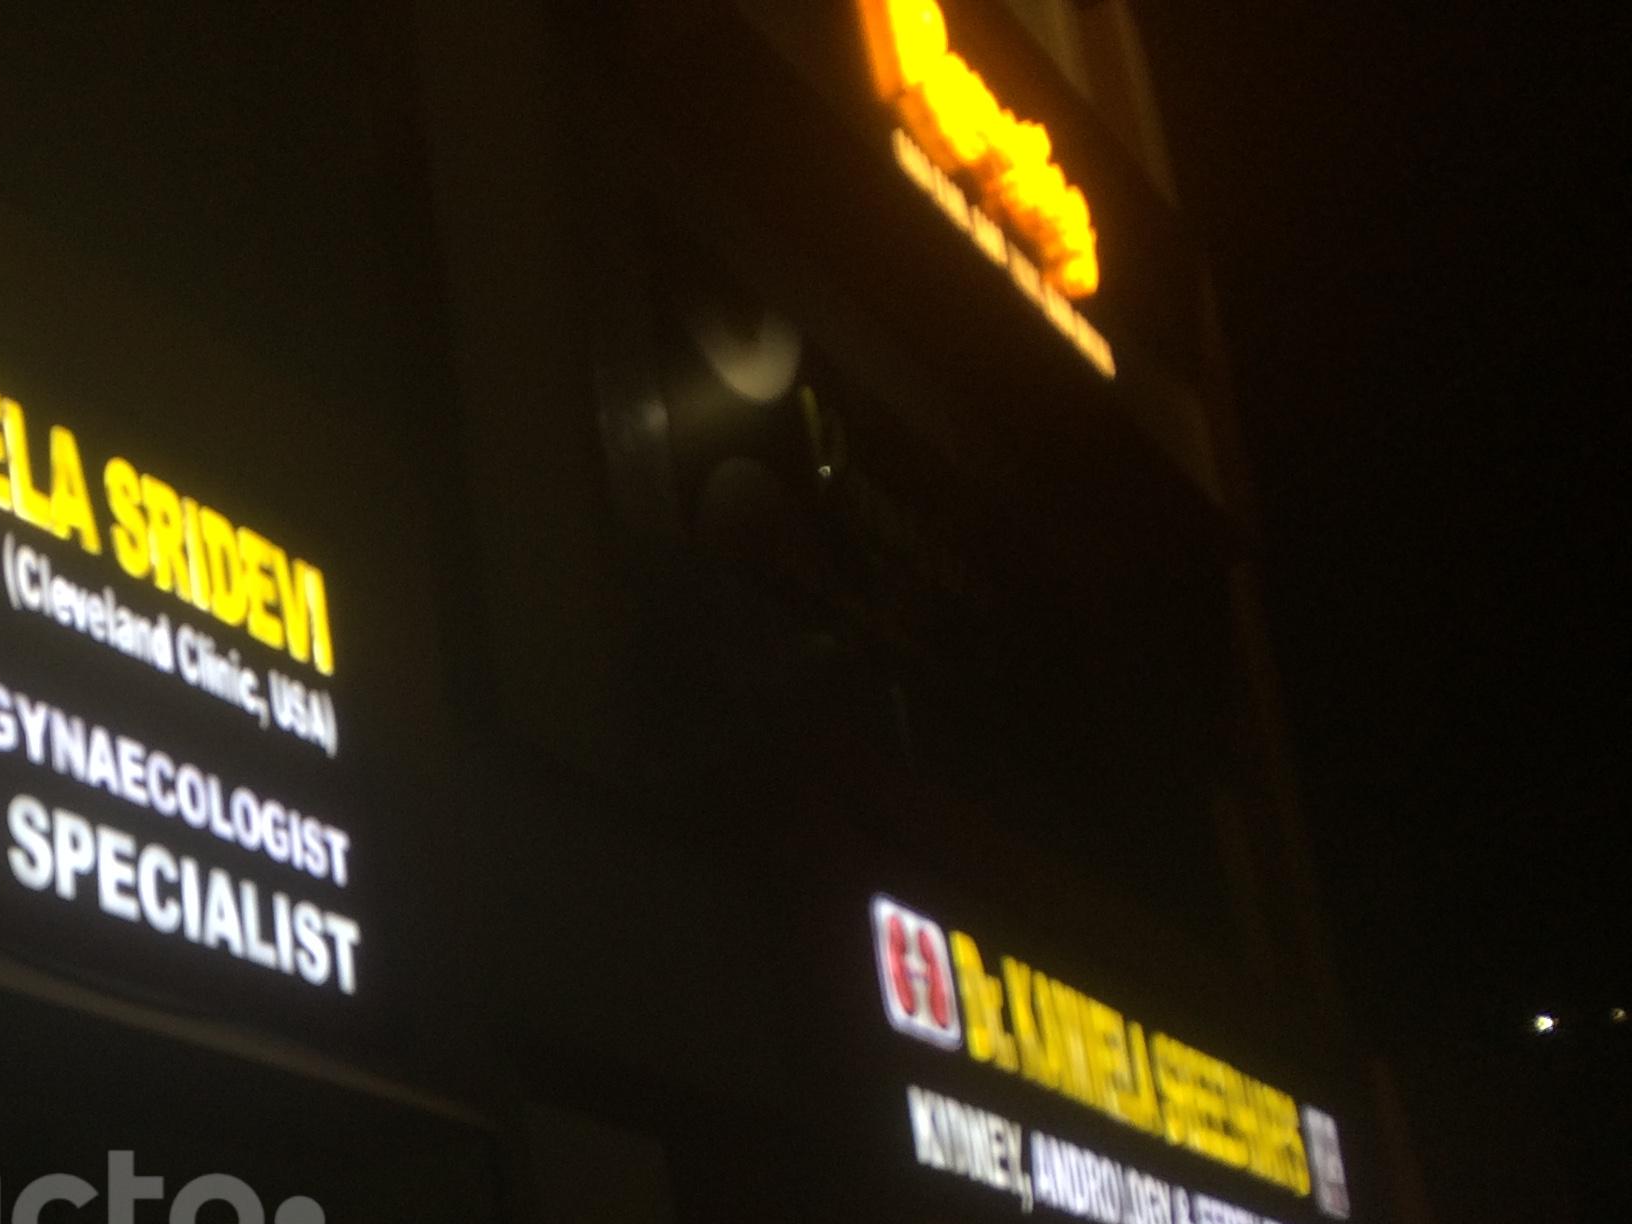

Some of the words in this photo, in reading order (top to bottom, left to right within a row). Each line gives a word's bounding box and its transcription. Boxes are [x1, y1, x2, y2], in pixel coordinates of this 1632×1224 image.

[2, 531, 175, 674] (Cleveland
[269, 669, 338, 760] USA)
[104, 456, 334, 677] SRIDEVI
[7, 794, 360, 996] SPECIALIST
